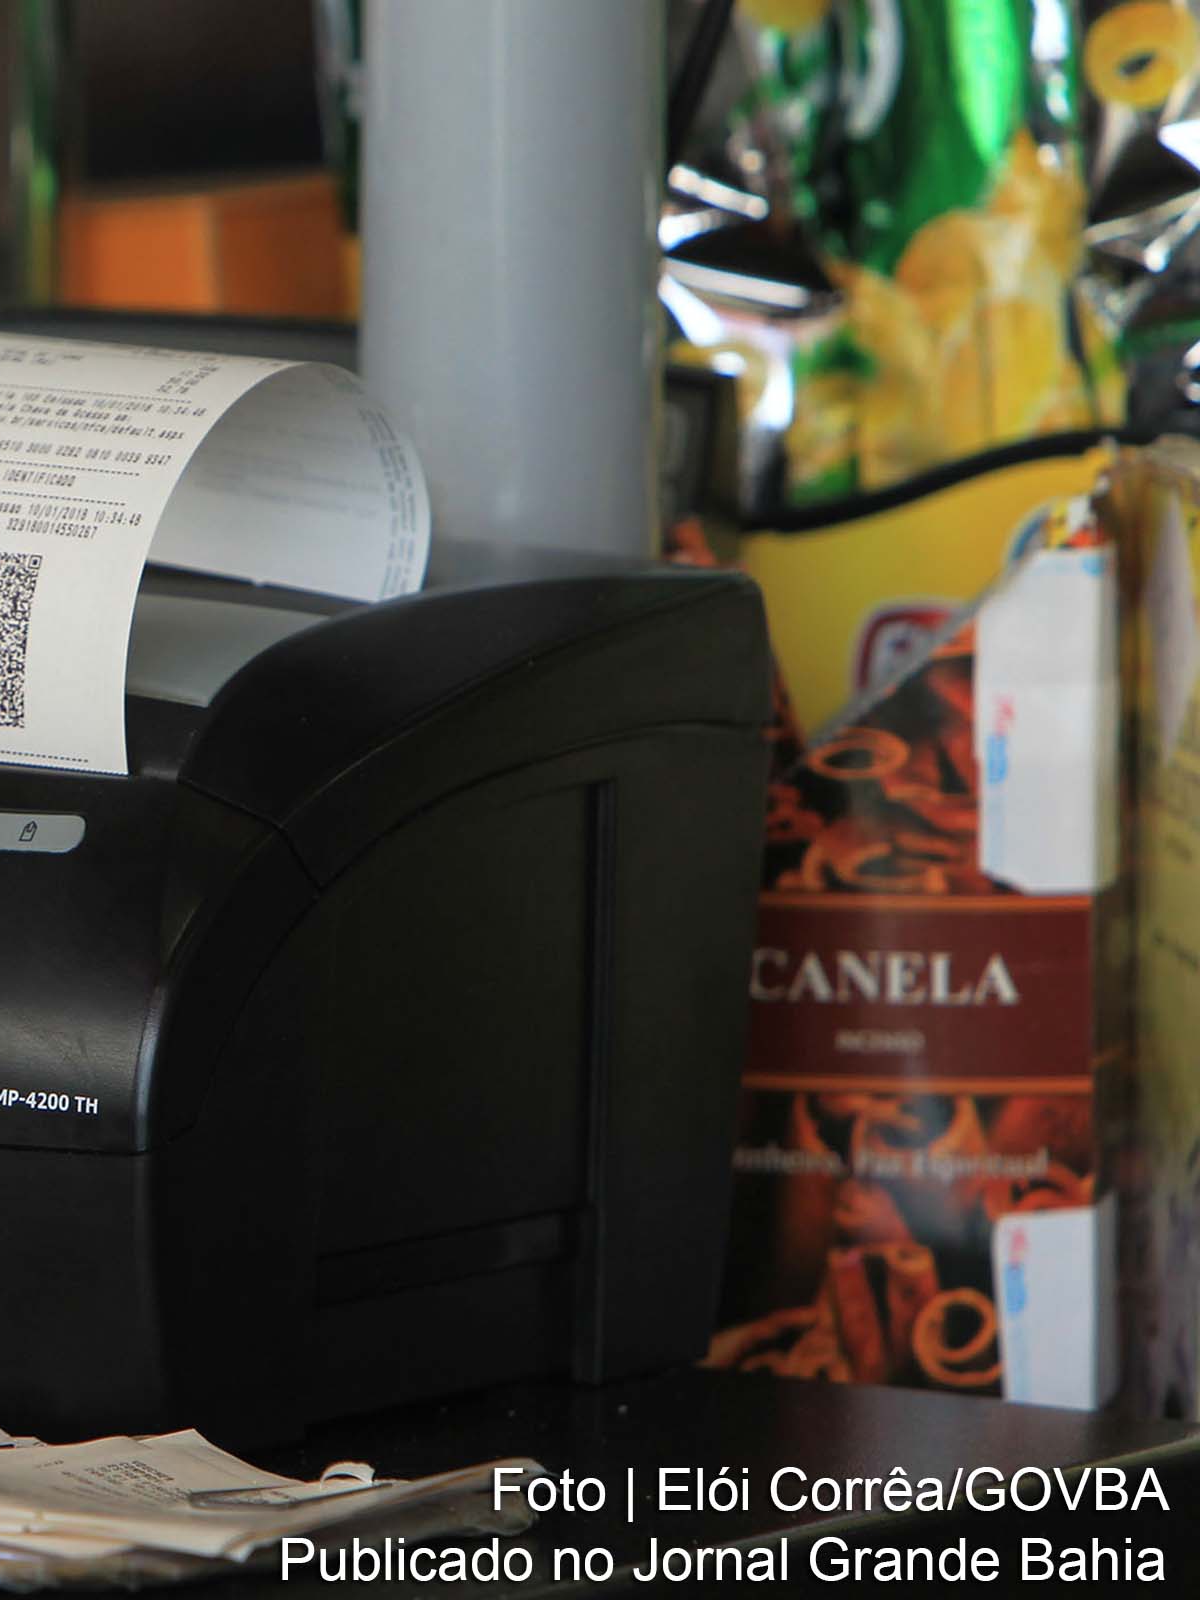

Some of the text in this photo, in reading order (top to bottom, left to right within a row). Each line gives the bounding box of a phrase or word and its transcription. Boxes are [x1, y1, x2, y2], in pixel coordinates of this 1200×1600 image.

[2, 469, 77, 488] IDENTIFICADO
[748, 948, 1021, 1007] CANELA
[74, 1095, 99, 1115] TH
